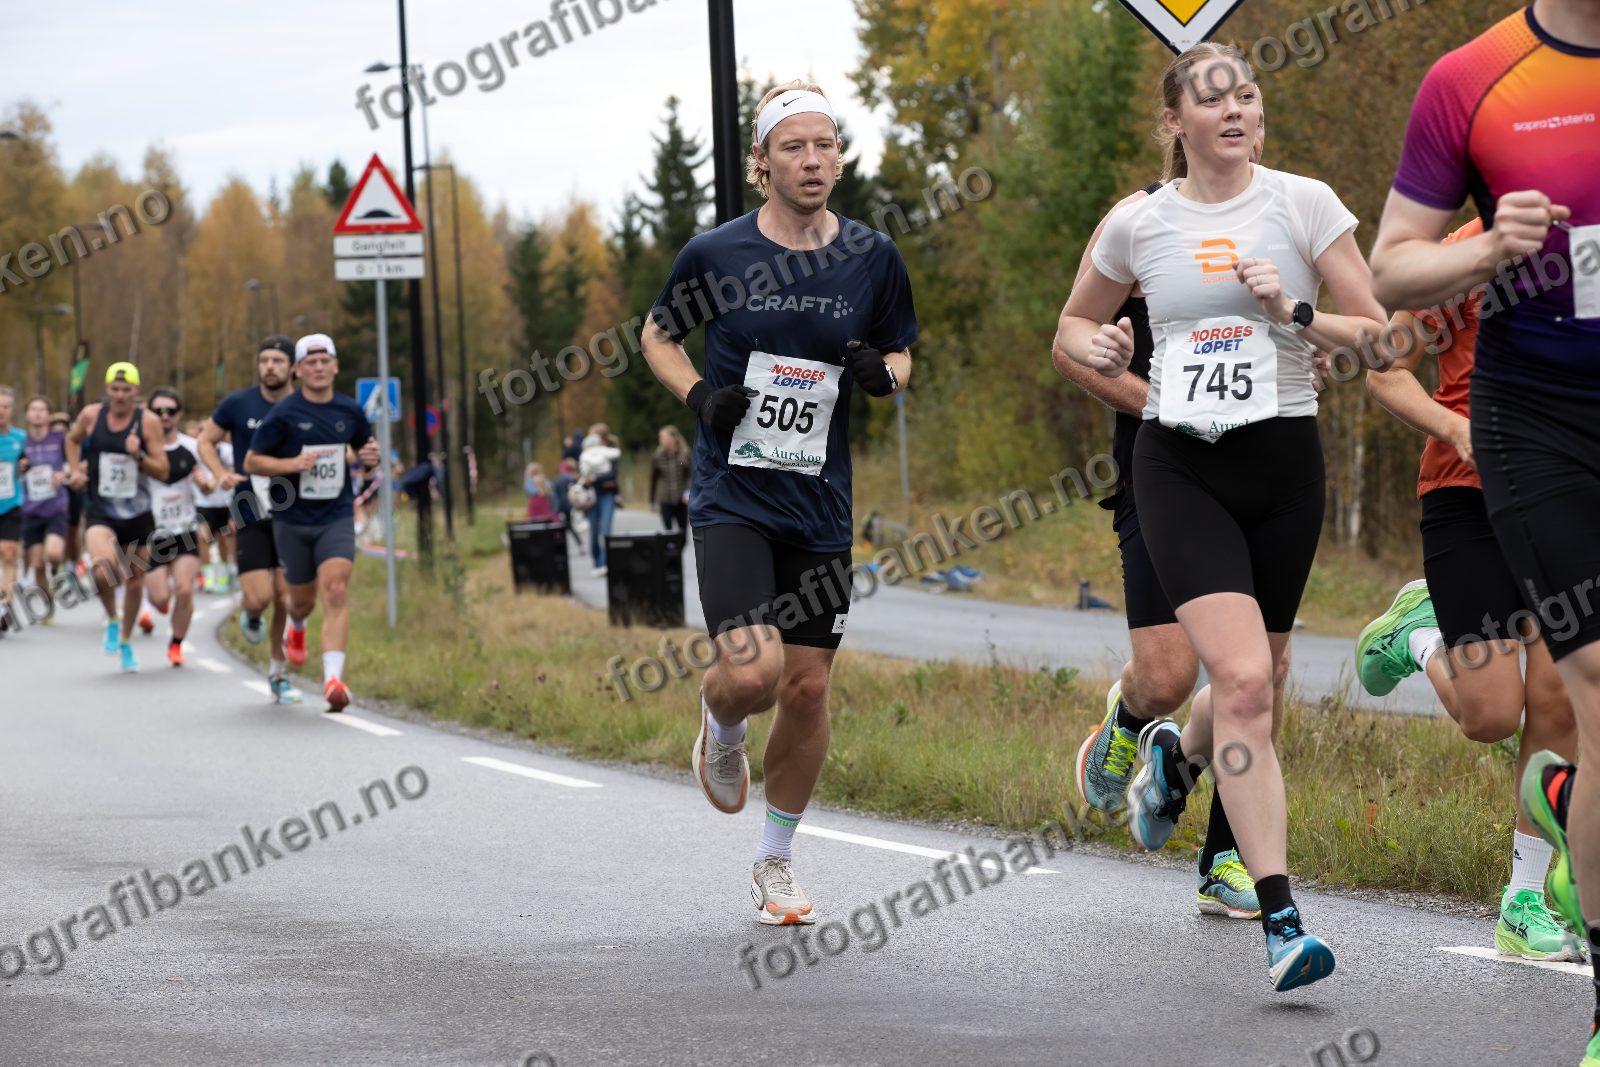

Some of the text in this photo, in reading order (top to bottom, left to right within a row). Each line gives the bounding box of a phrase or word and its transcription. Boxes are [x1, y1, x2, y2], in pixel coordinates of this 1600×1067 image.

[1513, 112, 1595, 131] sopra steria
[746, 295, 832, 313] CRAFT
[1189, 325, 1254, 342] NORGES
[1193, 339, 1243, 354] LØPET
[770, 364, 826, 381] NORGES
[1183, 362, 1253, 401] 745
[773, 375, 818, 391] LØPET
[757, 394, 819, 434] 505
[771, 446, 822, 464] Aurskog
[310, 462, 337, 480] 405
